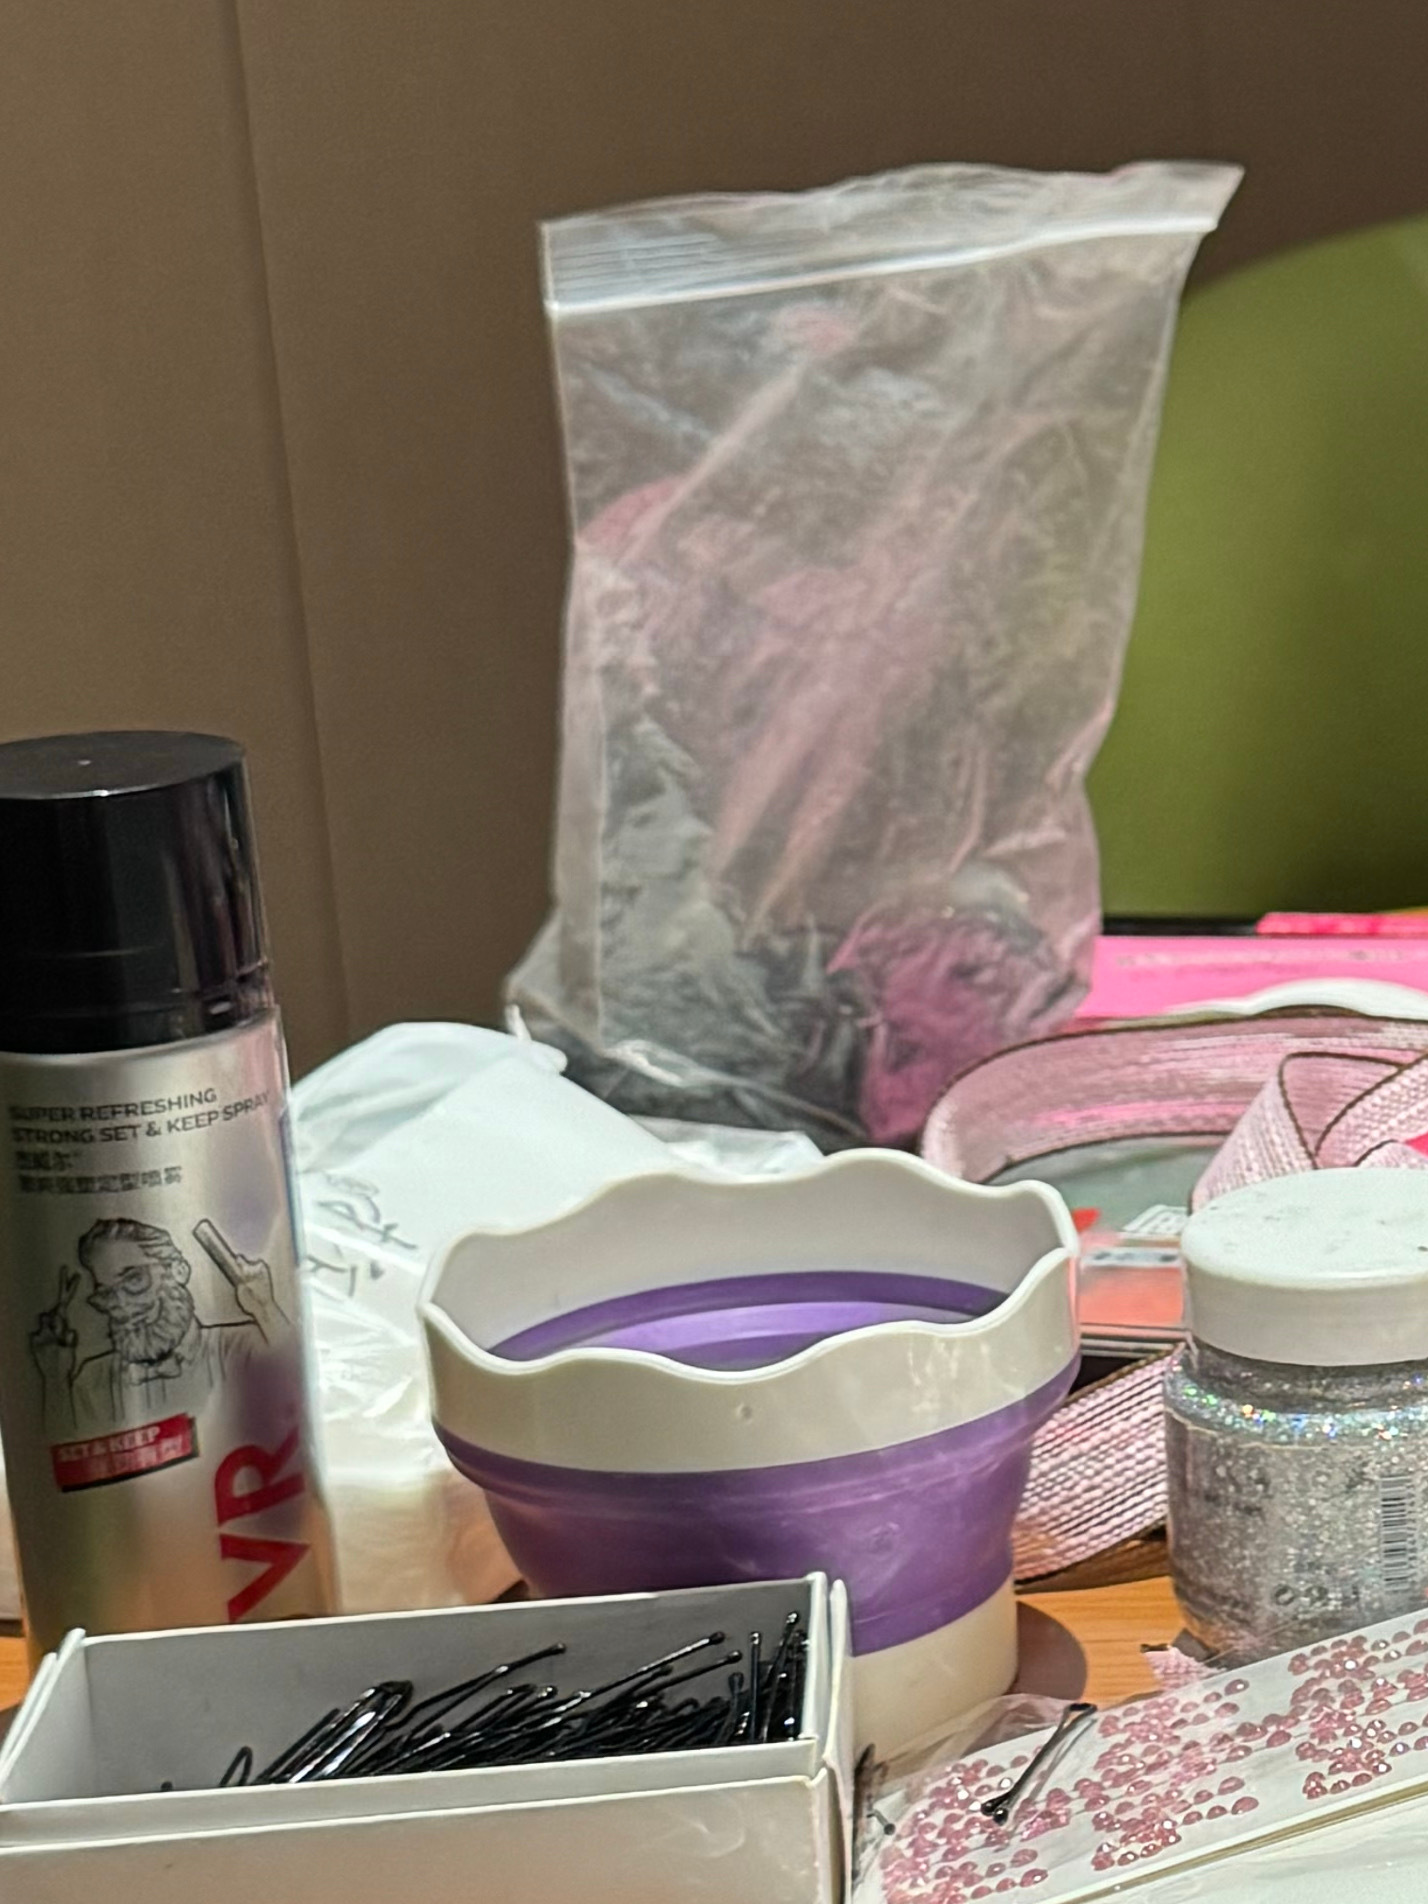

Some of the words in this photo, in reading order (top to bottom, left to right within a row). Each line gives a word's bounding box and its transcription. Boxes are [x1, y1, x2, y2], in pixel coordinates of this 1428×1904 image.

[9, 1105, 76, 1122] SUPER
[80, 1088, 217, 1121] REFRESHING
[12, 1127, 95, 1144] STRONG
[100, 1124, 141, 1142] SET
[145, 1122, 162, 1137] &
[166, 1110, 219, 1134] KEEP
[221, 1092, 270, 1122] SPRAY
